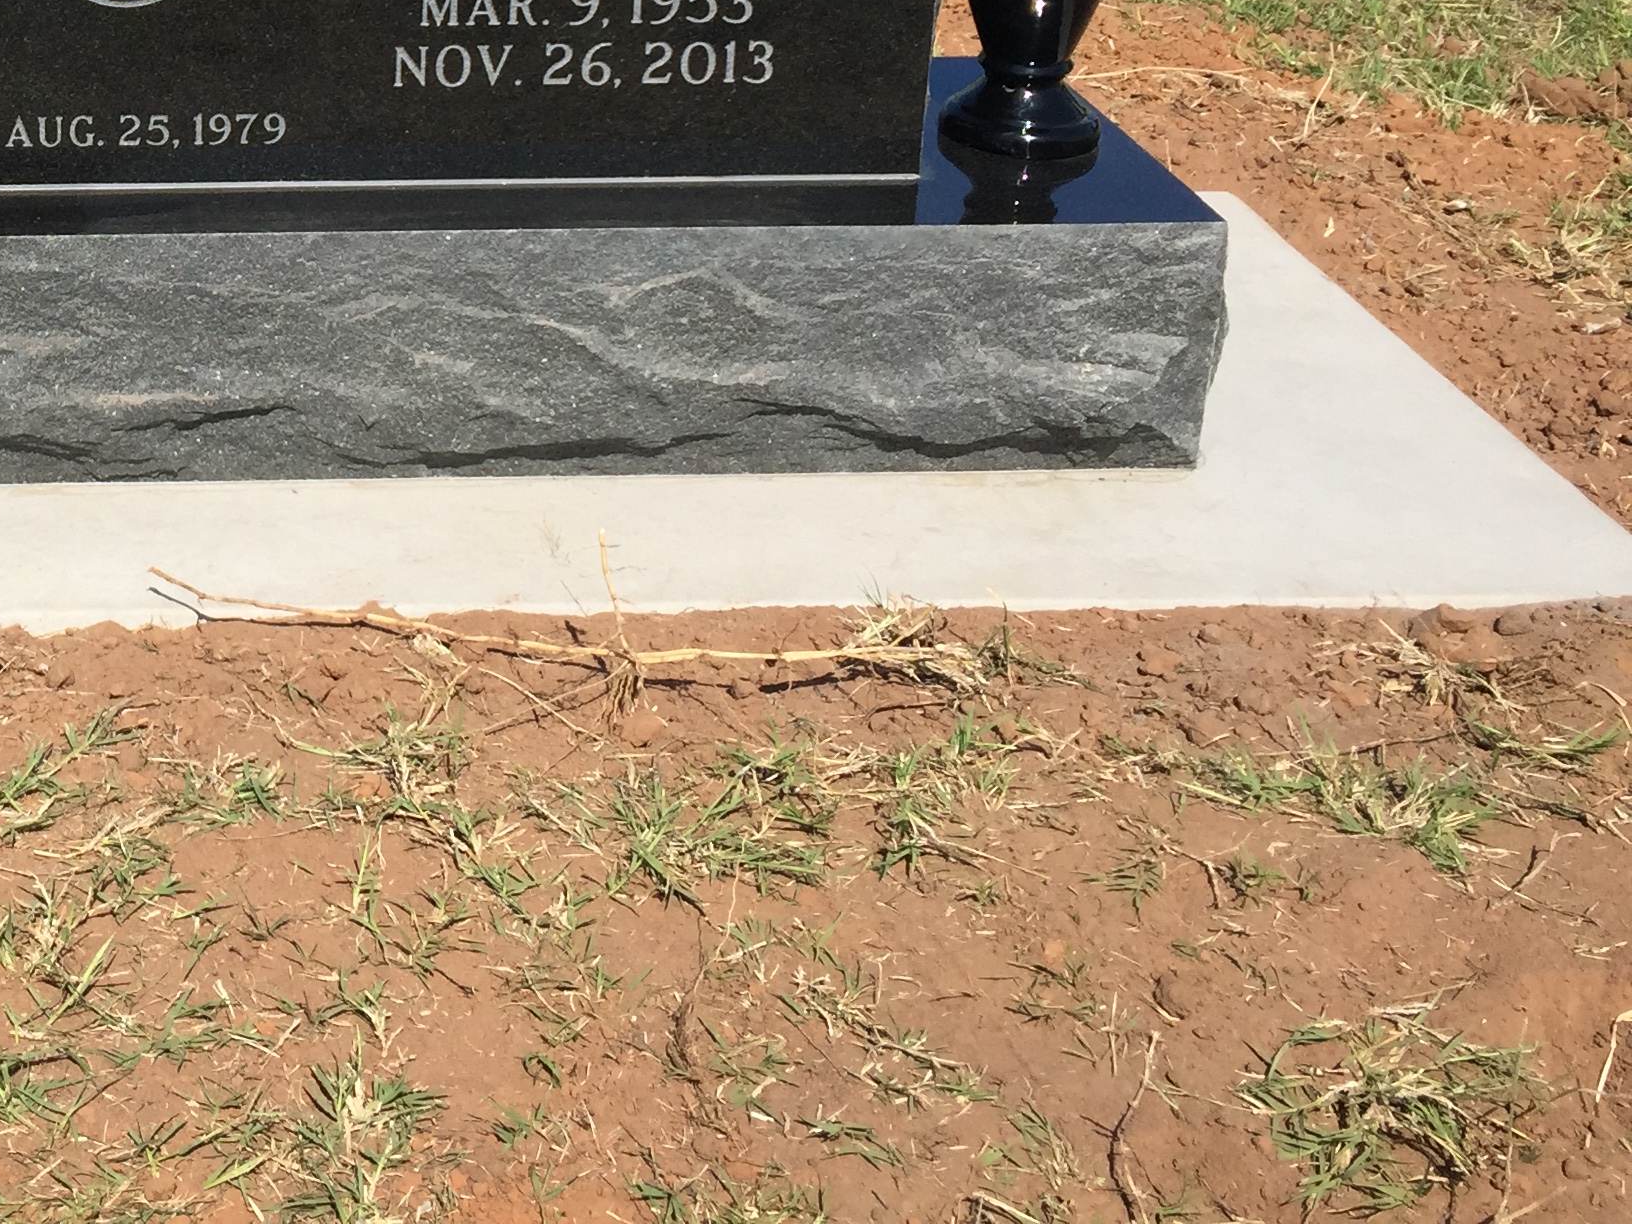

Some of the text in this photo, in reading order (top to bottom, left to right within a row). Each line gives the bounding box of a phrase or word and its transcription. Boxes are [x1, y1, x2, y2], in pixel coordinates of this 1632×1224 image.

[393, 39, 774, 89] NOV. 26, 2013
[5, 114, 105, 148] AUG.
[118, 114, 180, 149] 25,
[192, 112, 286, 146] 1979
